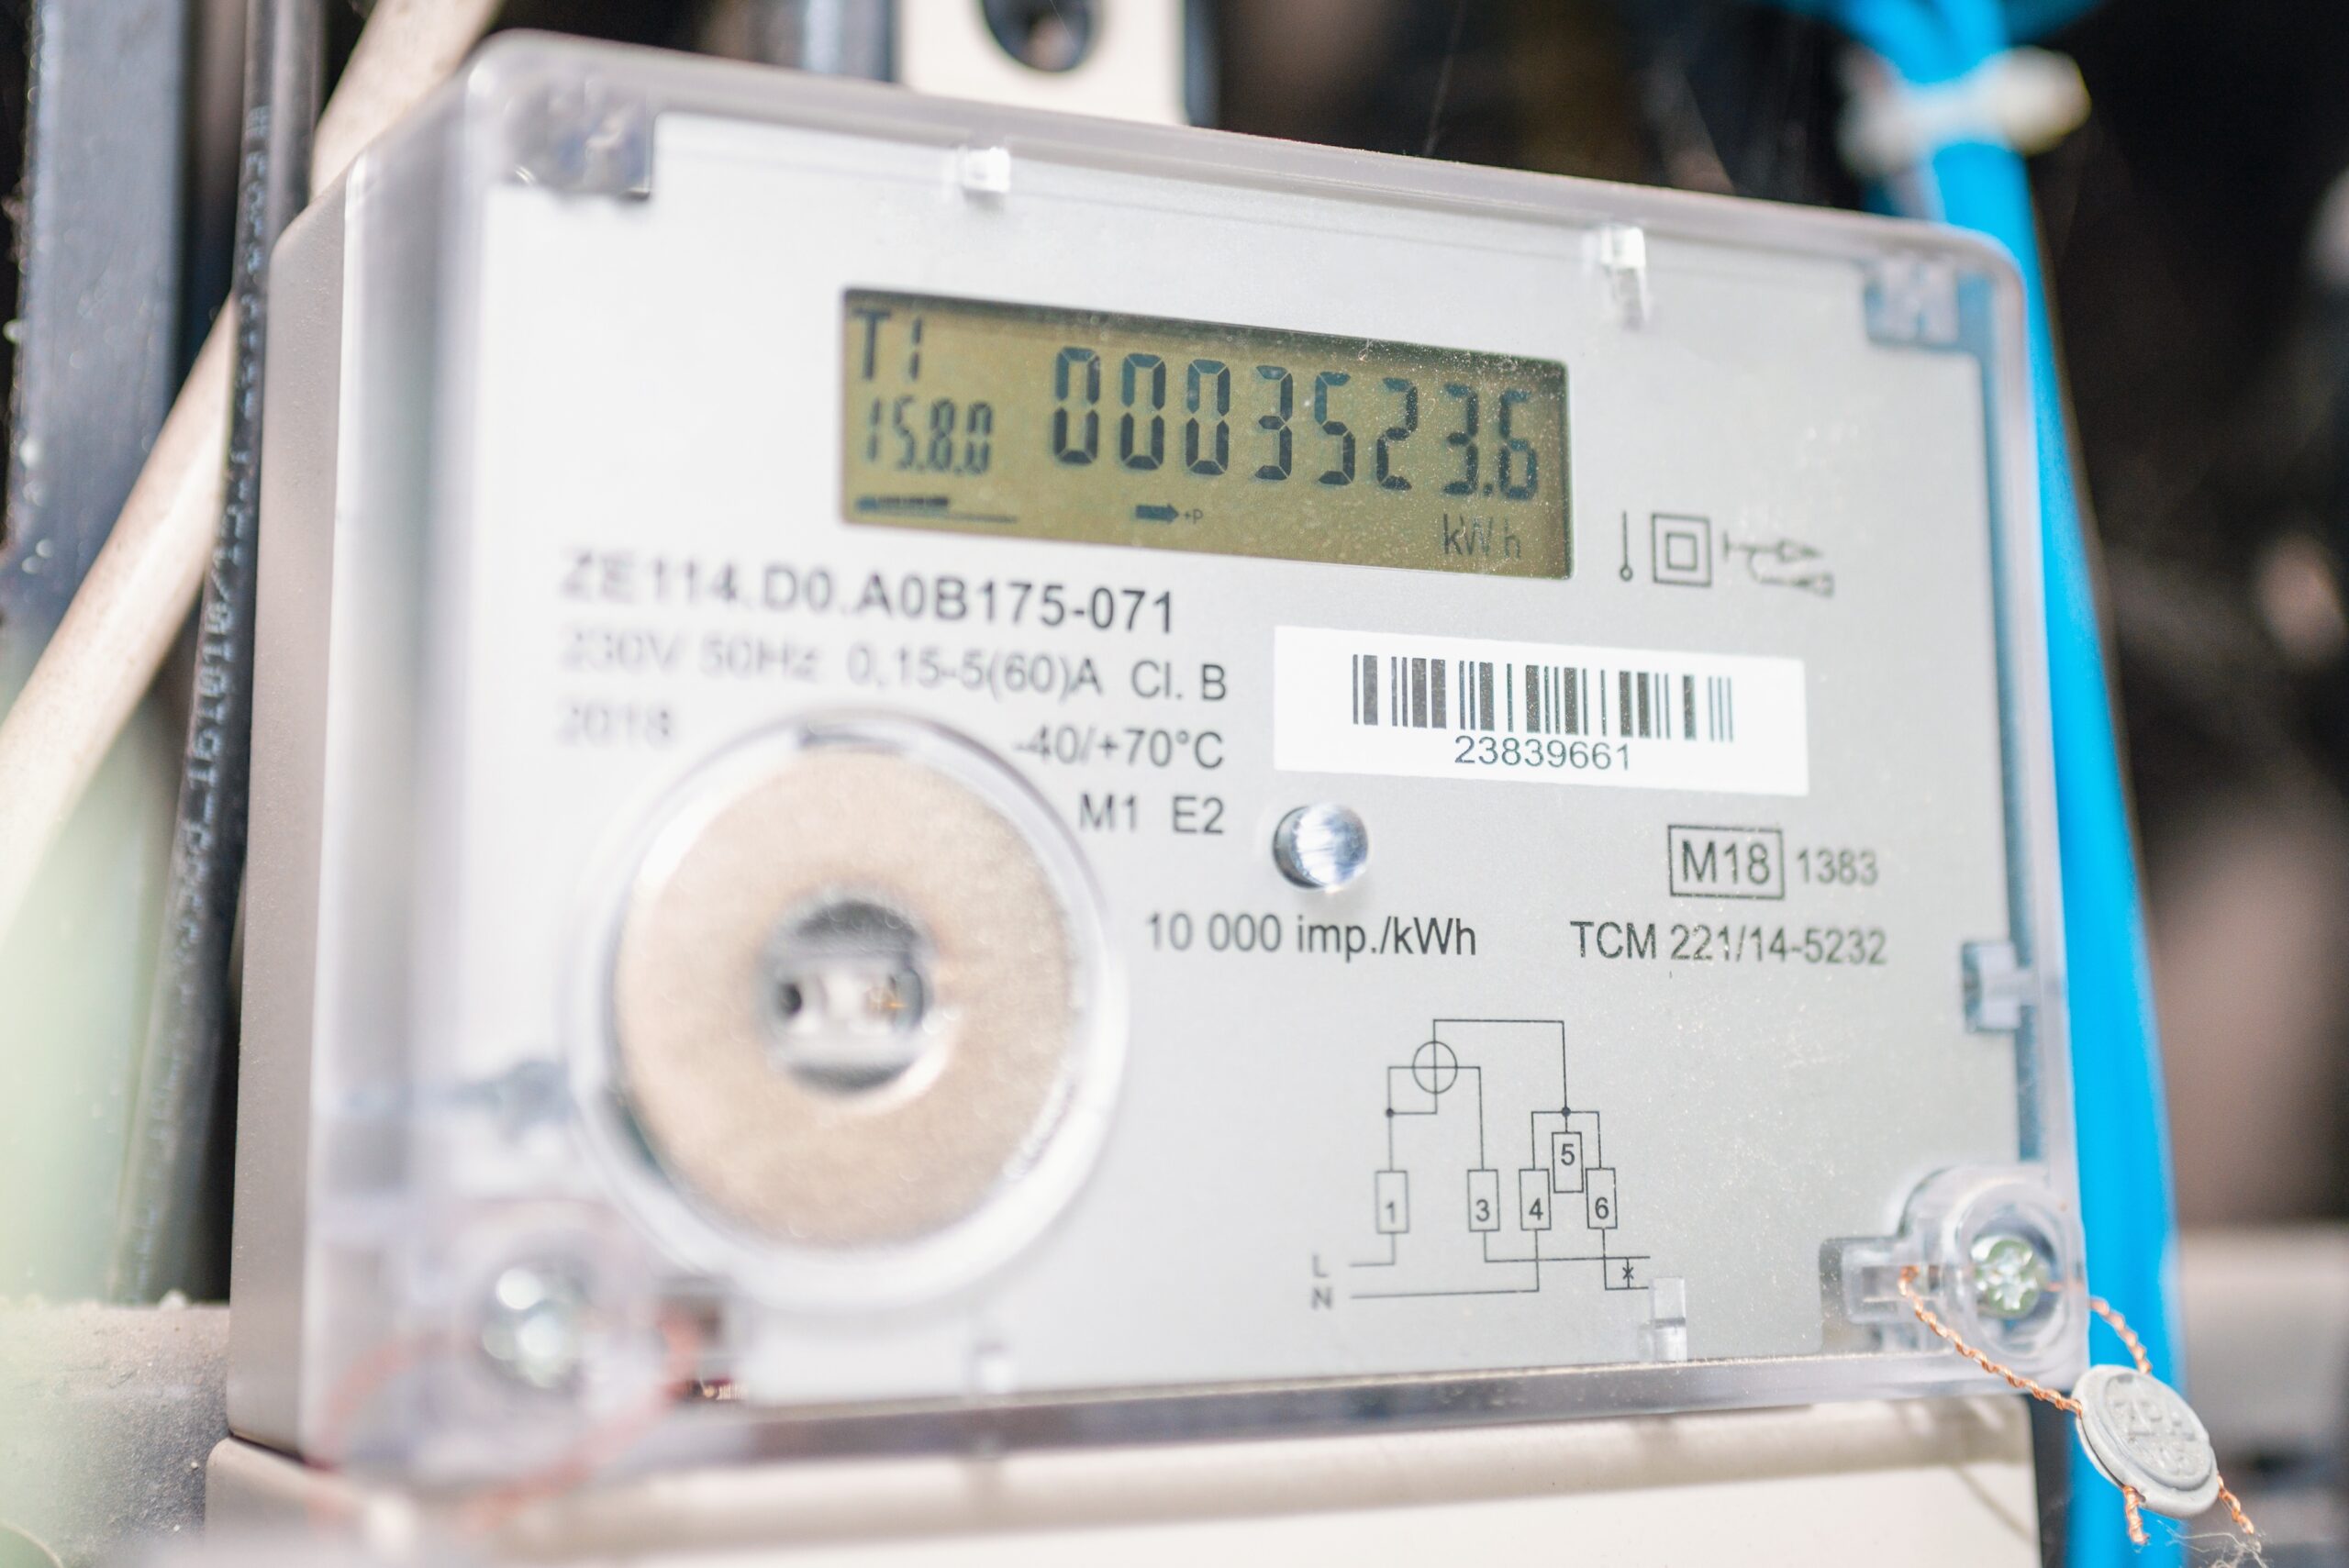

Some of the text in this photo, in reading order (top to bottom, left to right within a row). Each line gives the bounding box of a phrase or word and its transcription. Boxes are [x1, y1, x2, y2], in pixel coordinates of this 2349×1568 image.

[853, 308, 922, 380] T1
[866, 346, 1538, 501] 15.8.0 0003523.6
[562, 548, 1173, 633] ZE114.D0.A0B175-071
[562, 628, 681, 674] 230V
[699, 633, 820, 683] 50Hz
[1201, 662, 1228, 701] B
[562, 700, 674, 751] 2018
[1013, 725, 1225, 771] -40/+70°C
[1453, 734, 1631, 772] 23839661
[1077, 792, 1226, 836] M1 E2
[1680, 840, 1879, 886] M18 1383
[1147, 912, 1477, 963] 10 000 imp./kWh
[1570, 920, 1888, 966] TCM 221/14-5232
[1560, 1142, 1575, 1166] 5
[1384, 1199, 1397, 1225] 1
[1475, 1198, 1491, 1222] 3
[1528, 1197, 1544, 1220] 4
[1595, 1195, 1610, 1219] 6
[1311, 1253, 1330, 1279] L
[1311, 1285, 1334, 1310] N
